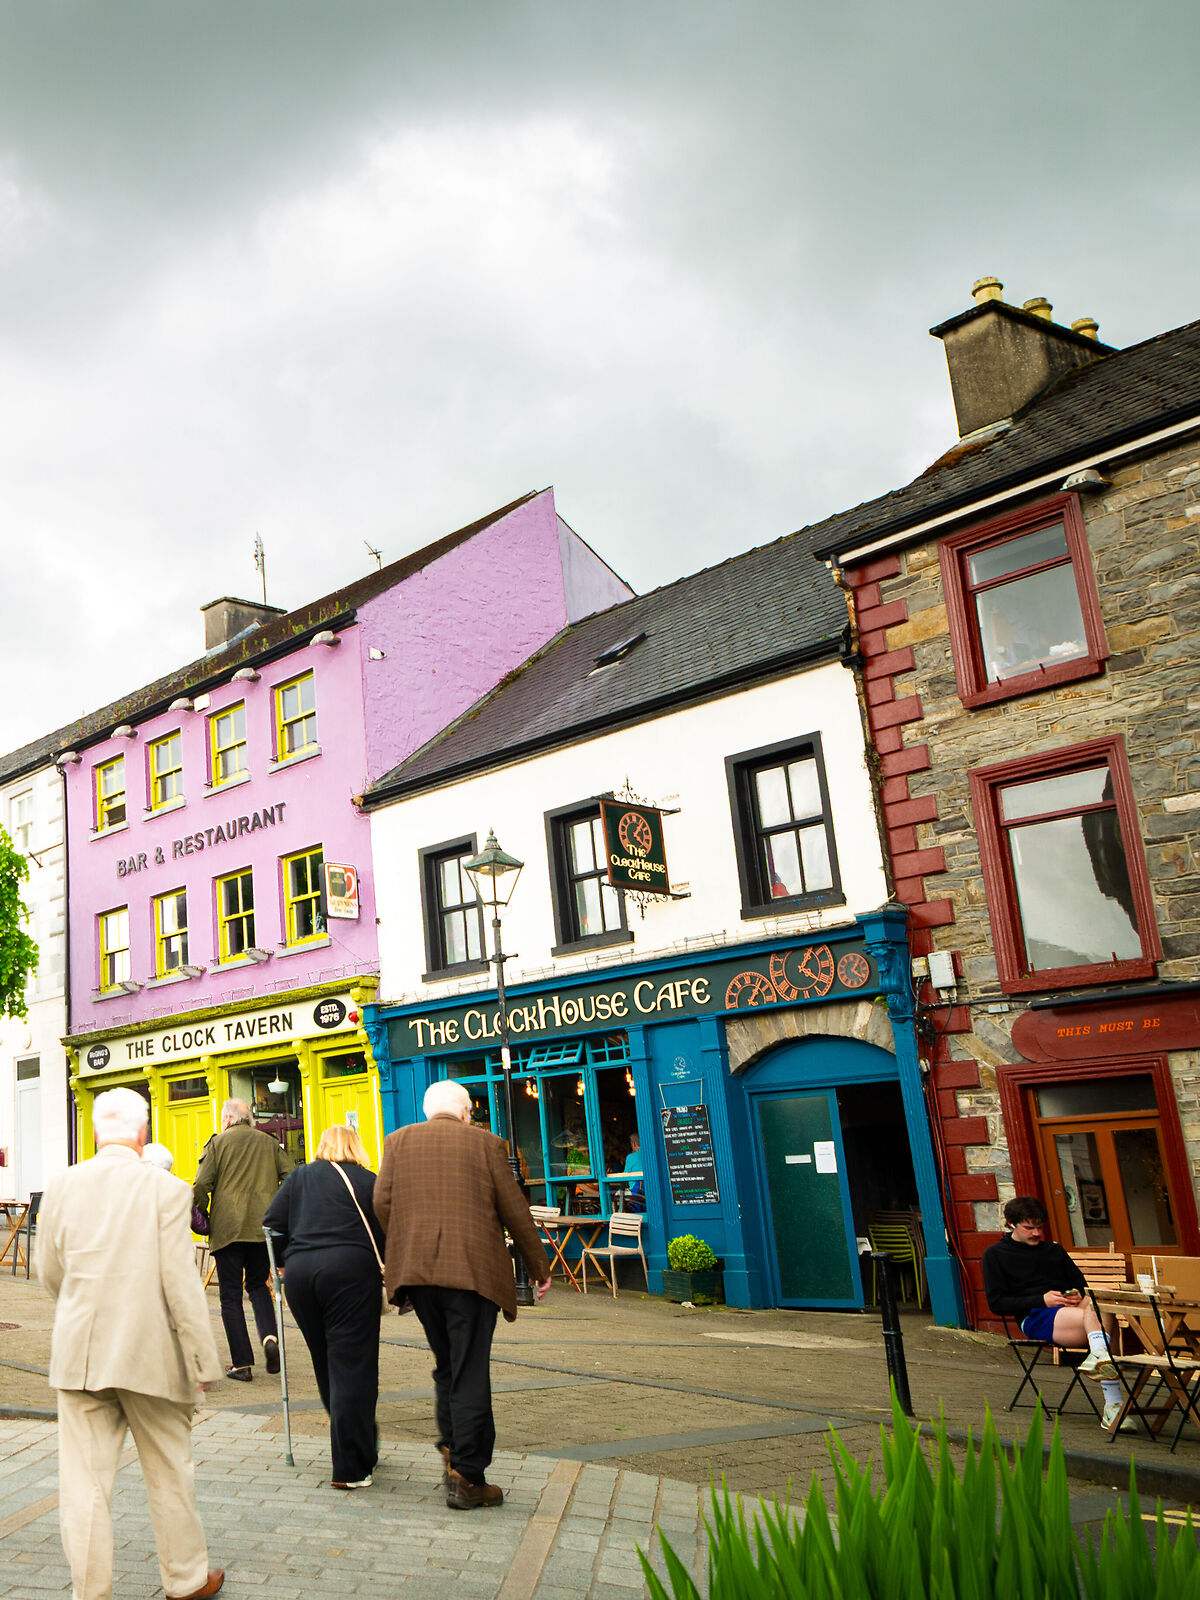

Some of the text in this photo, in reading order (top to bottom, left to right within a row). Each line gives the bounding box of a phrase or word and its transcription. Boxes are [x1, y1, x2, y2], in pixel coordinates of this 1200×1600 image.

[116, 802, 287, 877] BAR & RESTAURANT
[320, 1013, 340, 1024] 1976
[1057, 1018, 1161, 1038] THIS MUST BE
[126, 1012, 294, 1060] THE CLOCK TAVERN
